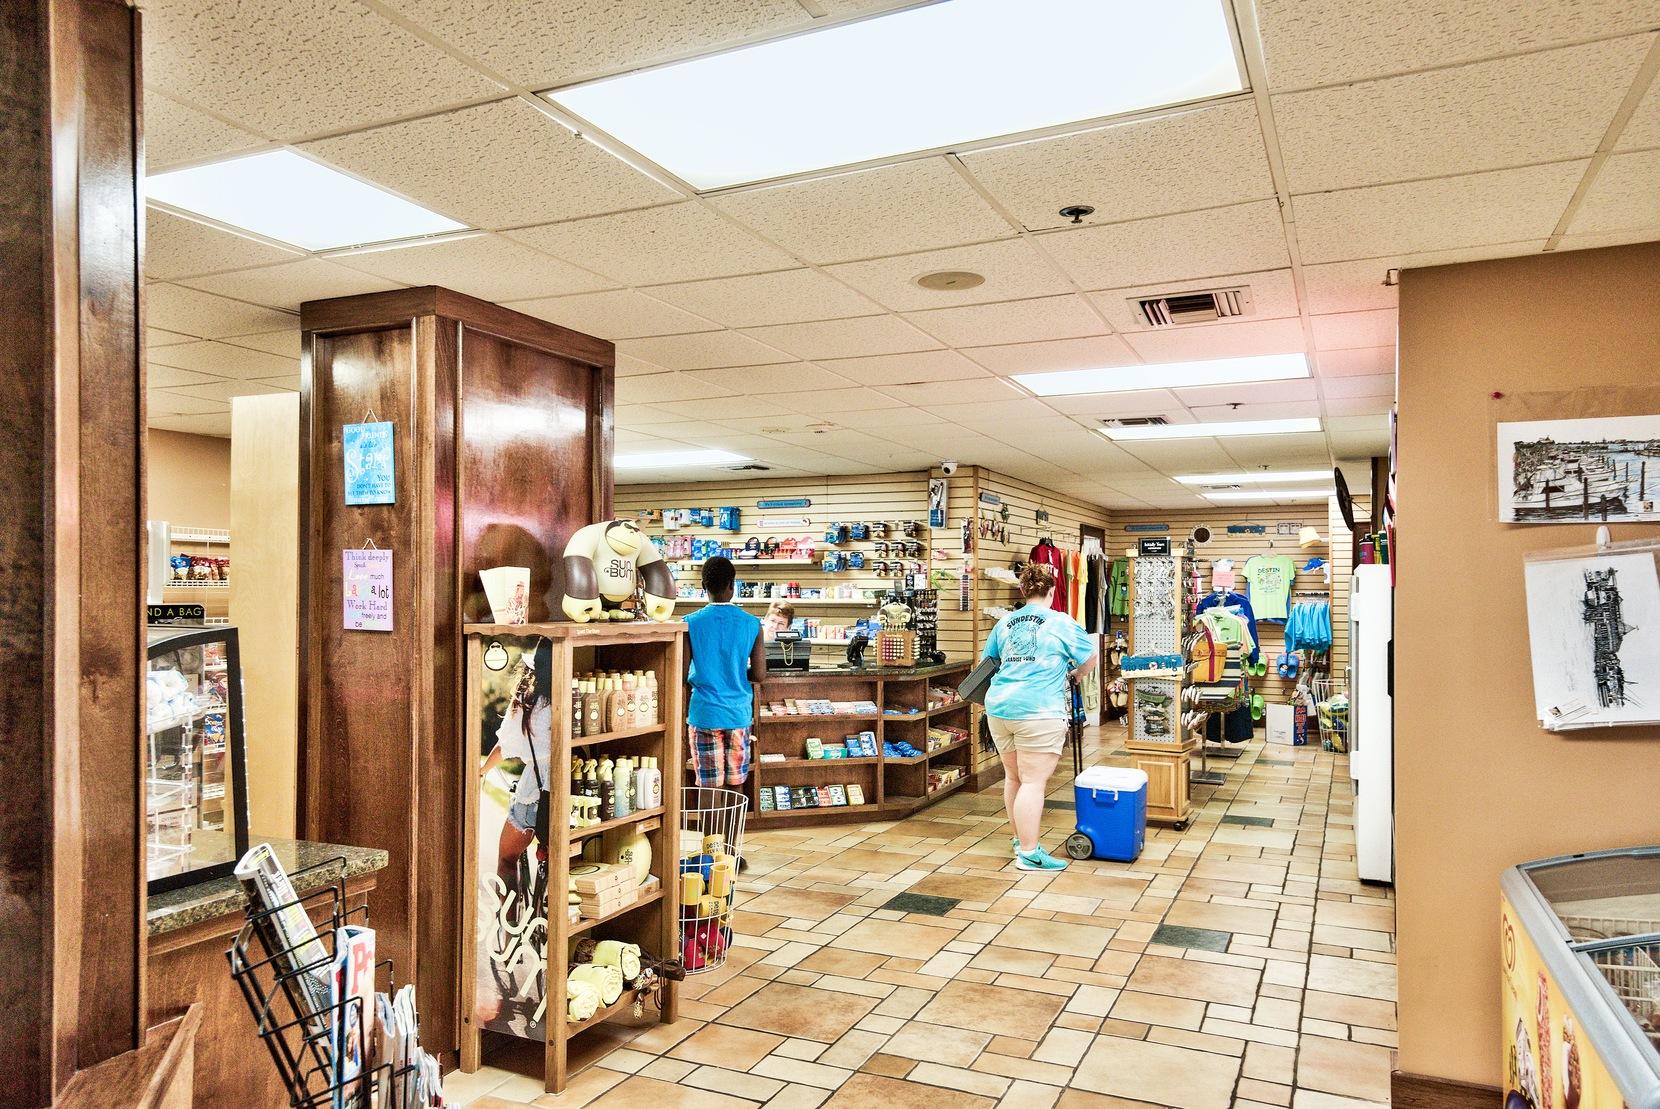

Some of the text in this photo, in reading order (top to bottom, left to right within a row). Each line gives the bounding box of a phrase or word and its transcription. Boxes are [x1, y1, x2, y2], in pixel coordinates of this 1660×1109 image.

[345, 551, 389, 563] Think deeply
[378, 584, 390, 599] lot
[347, 599, 388, 611] Work Hard
[166, 607, 175, 616] A
[179, 607, 202, 616] BAG
[376, 612, 387, 620] and
[1006, 614, 1046, 630] SUNDESTIN
